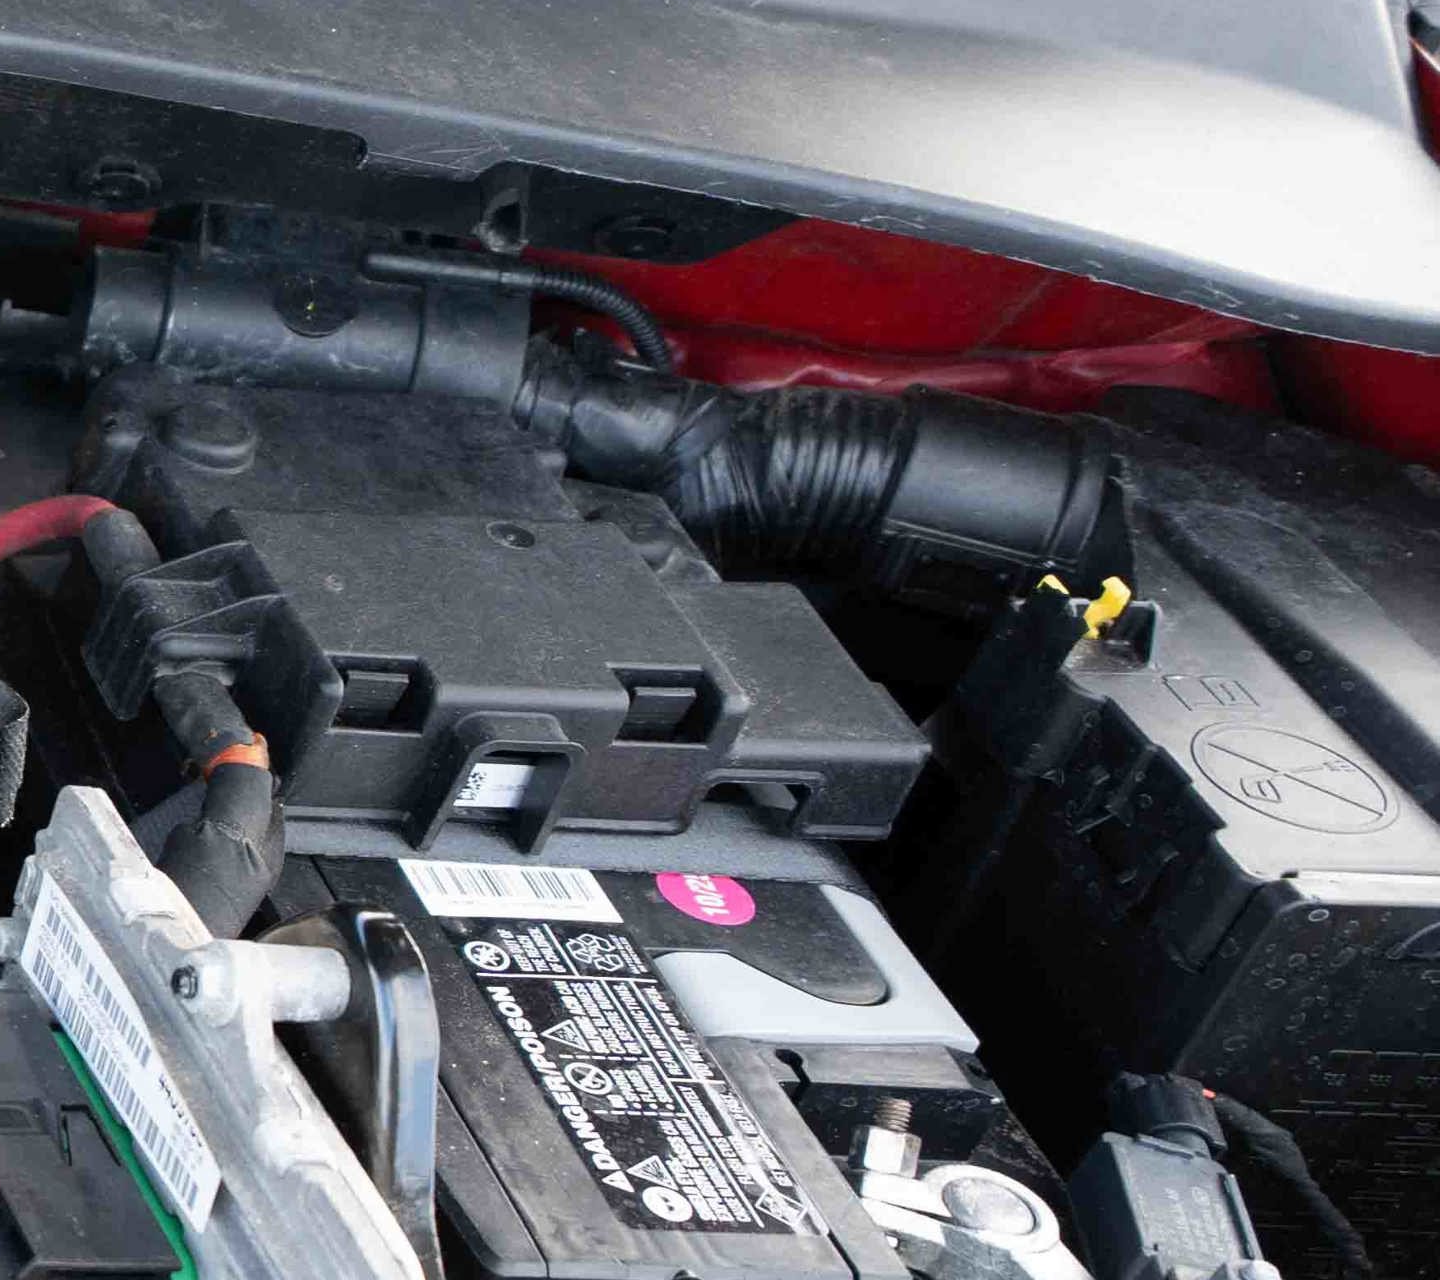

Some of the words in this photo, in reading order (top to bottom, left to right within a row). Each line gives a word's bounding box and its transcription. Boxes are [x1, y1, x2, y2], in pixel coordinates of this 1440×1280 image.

[655, 1050, 685, 1075] READ
[678, 1042, 704, 1061] NOT
[485, 985, 620, 1169] DANGER/POISON
